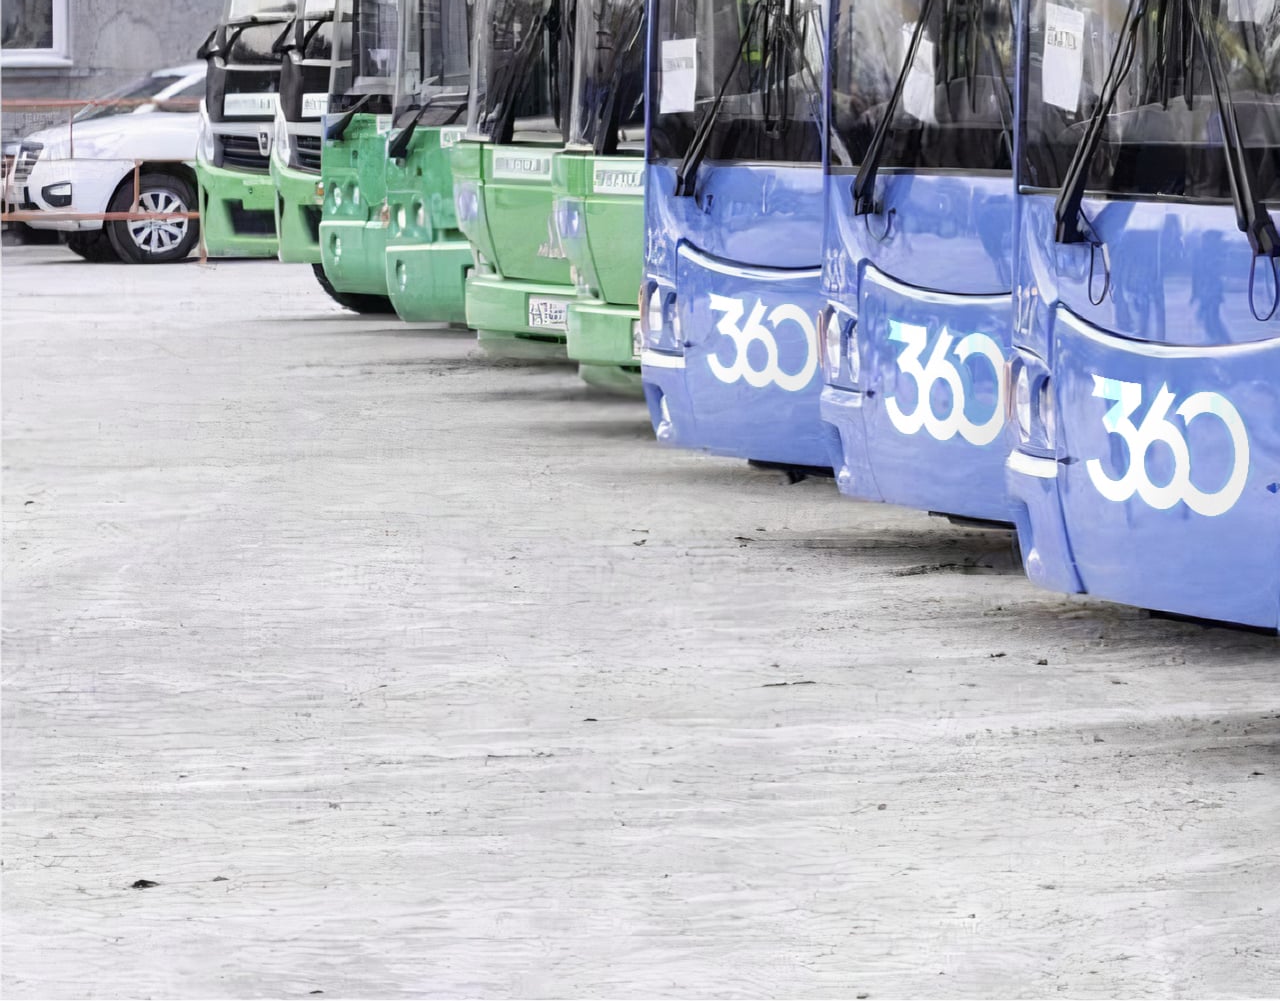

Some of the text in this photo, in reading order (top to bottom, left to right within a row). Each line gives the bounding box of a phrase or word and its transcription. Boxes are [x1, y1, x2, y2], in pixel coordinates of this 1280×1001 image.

[707, 292, 816, 391] 360
[884, 319, 1003, 445] 360
[1086, 374, 1250, 517] 360
